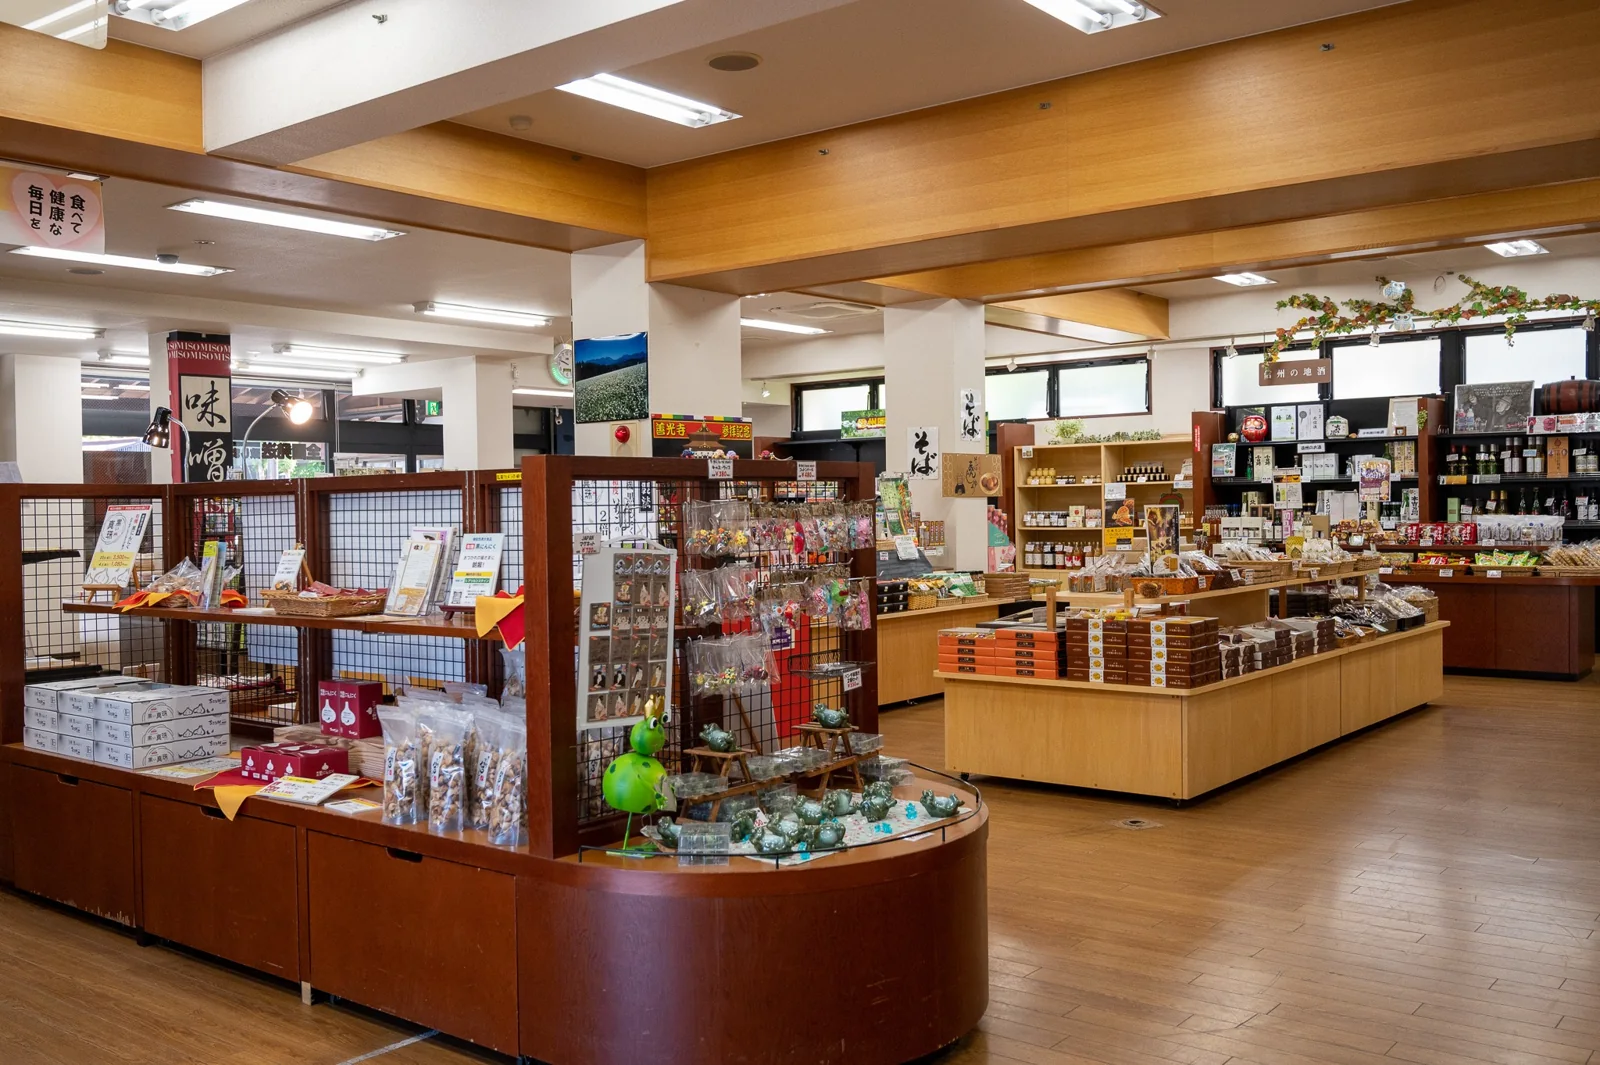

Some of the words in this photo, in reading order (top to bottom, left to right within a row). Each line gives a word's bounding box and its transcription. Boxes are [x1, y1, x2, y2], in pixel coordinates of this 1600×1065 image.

[28, 184, 44, 230] 毎日を
[49, 189, 65, 236] 健康な
[70, 194, 86, 234] 食べて
[185, 380, 227, 482] 味噌
[656, 422, 686, 437] 善光寺
[910, 431, 938, 477] そば
